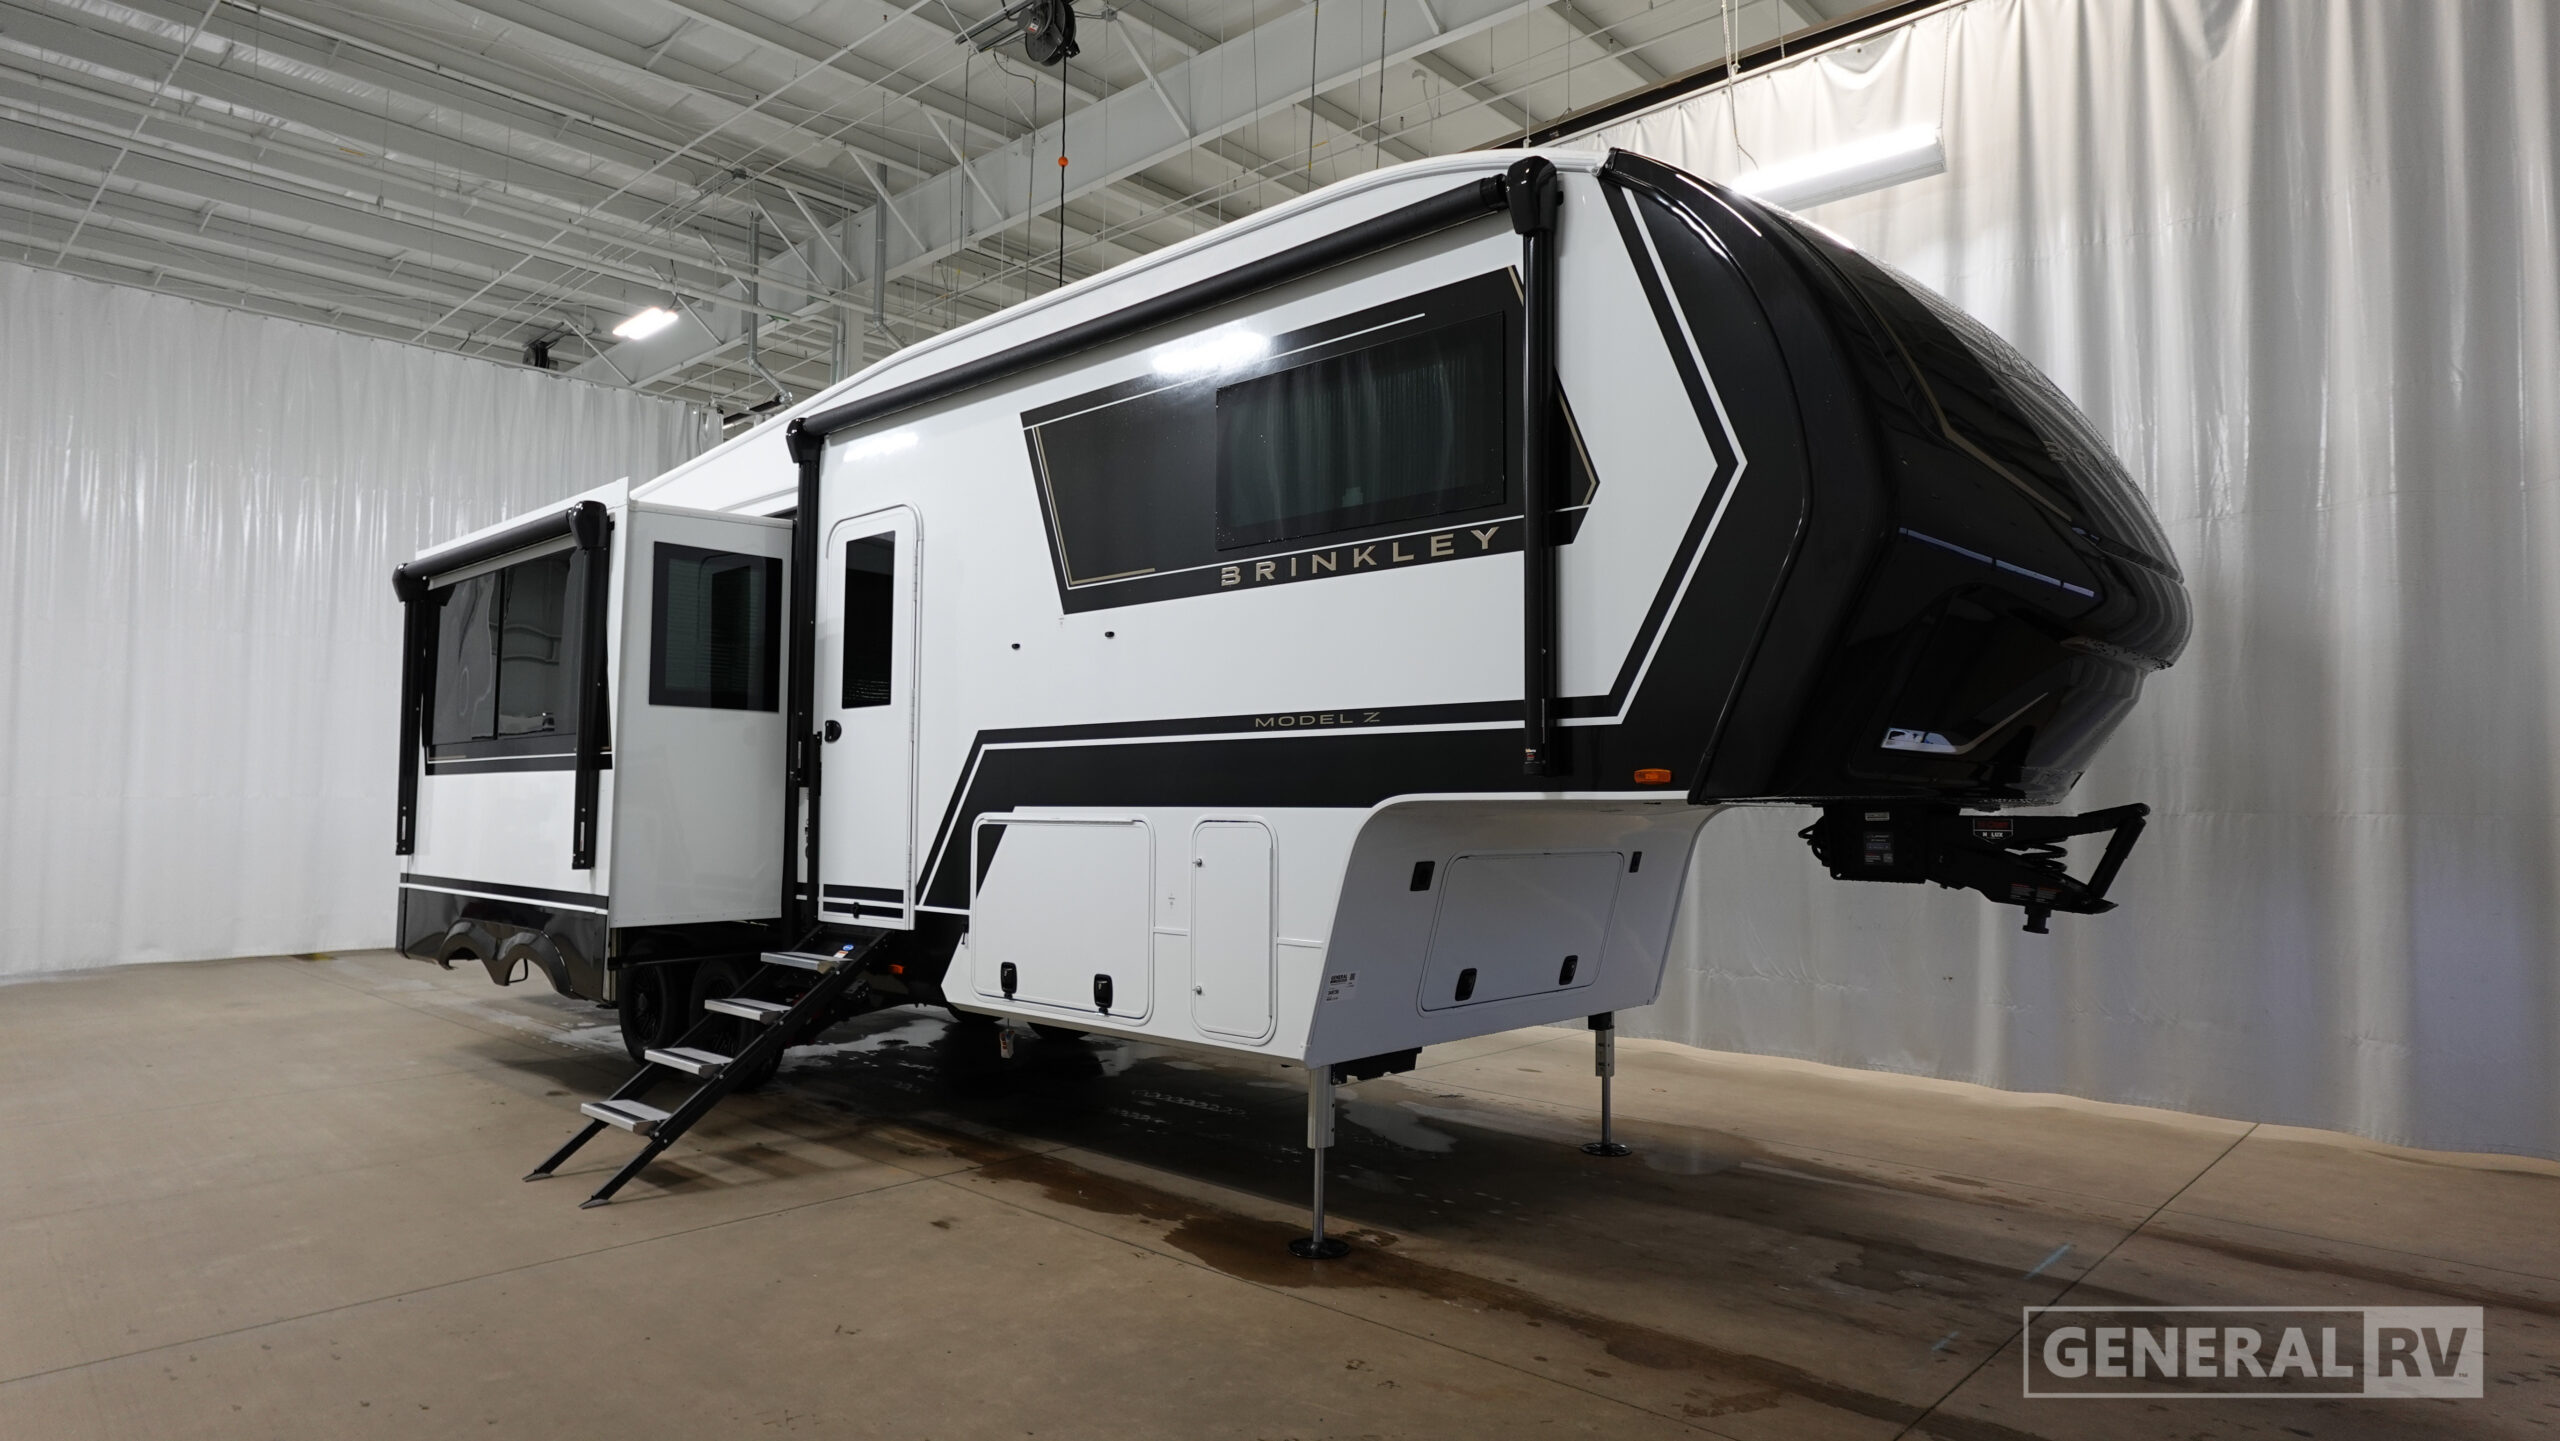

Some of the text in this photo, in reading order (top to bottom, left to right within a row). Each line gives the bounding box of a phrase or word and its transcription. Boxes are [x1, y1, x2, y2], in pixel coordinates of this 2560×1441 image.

[1221, 526, 1500, 587] BRINKLEY
[1255, 711, 1381, 728] MODEL Z
